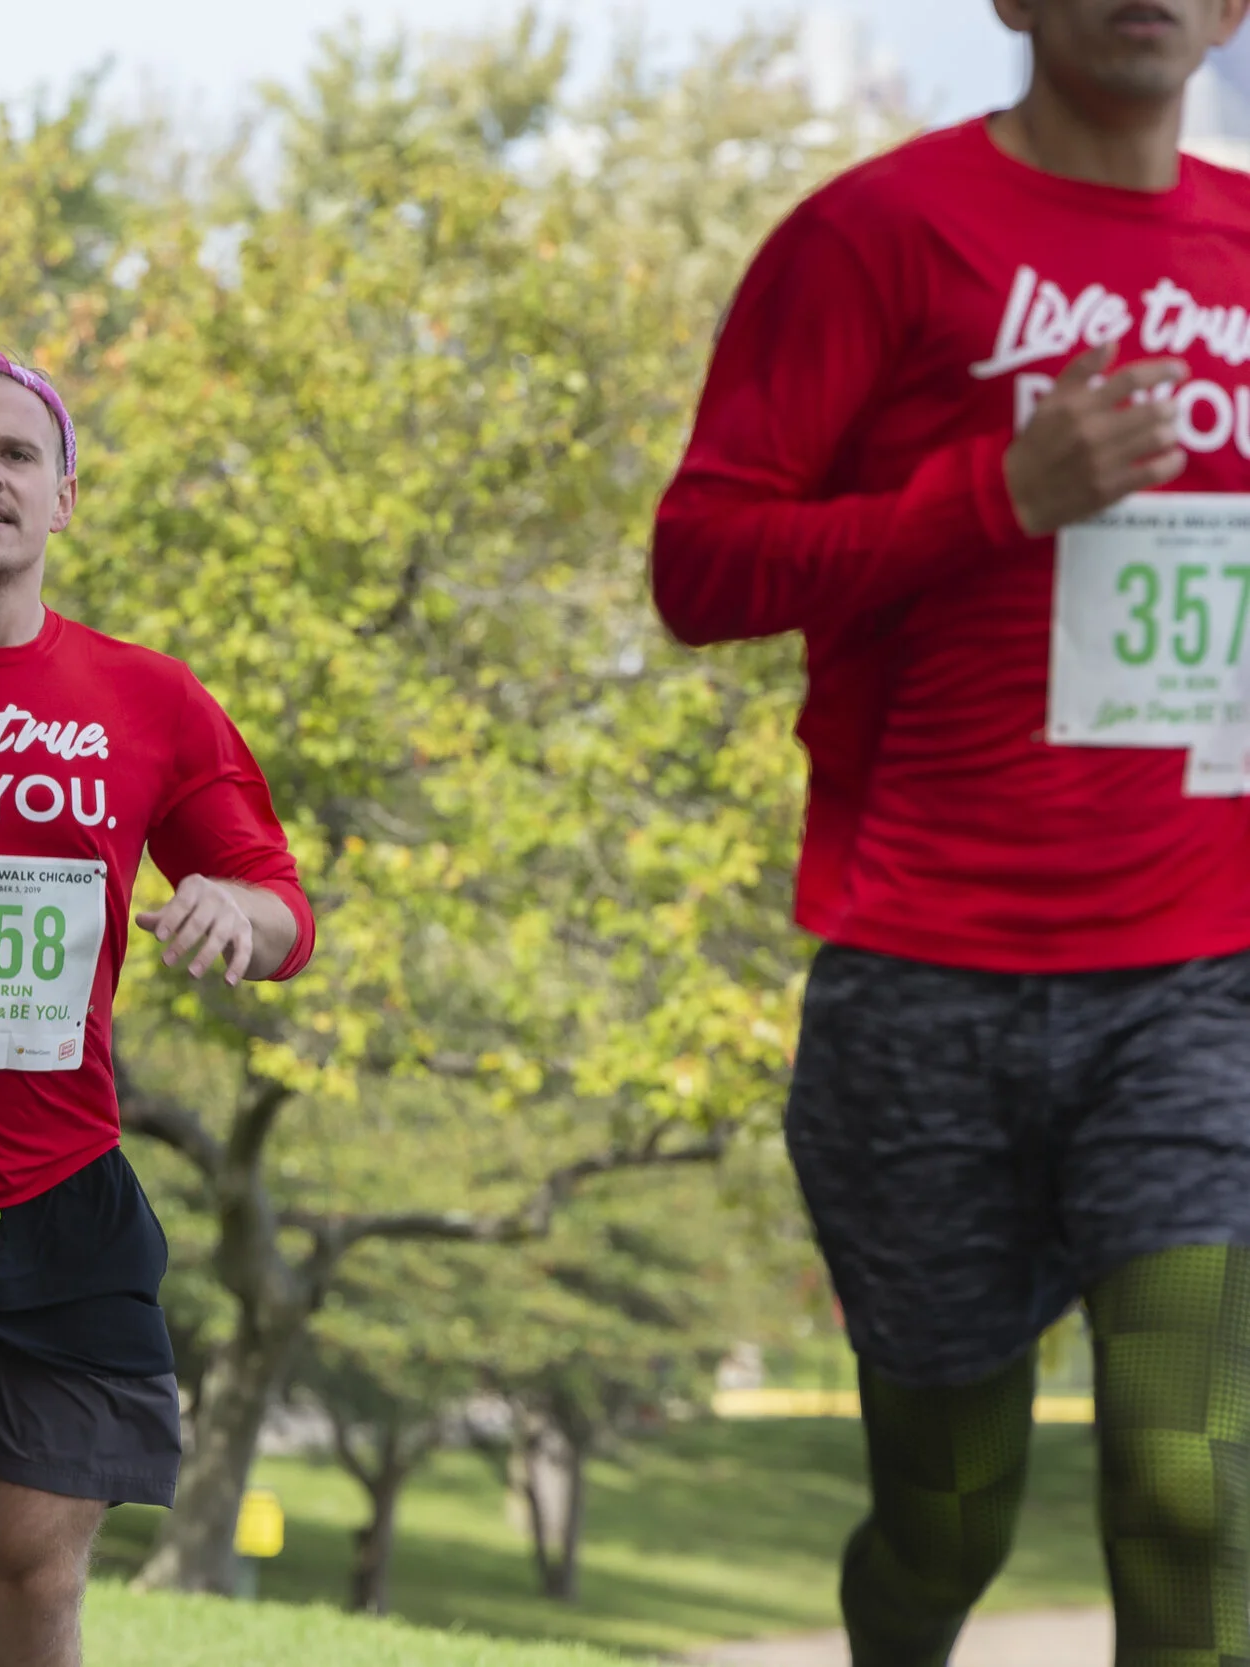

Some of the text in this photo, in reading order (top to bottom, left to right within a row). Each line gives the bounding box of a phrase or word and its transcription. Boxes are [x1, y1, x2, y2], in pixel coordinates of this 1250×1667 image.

[968, 263, 1250, 380] Live tru
[1112, 561, 1250, 667] 357
[39, 871, 93, 884] CHICAGO
[24, 886, 41, 894] 2019
[0, 984, 33, 997] RUN
[10, 1004, 30, 1020] BE
[36, 1005, 70, 1020] YOU.
